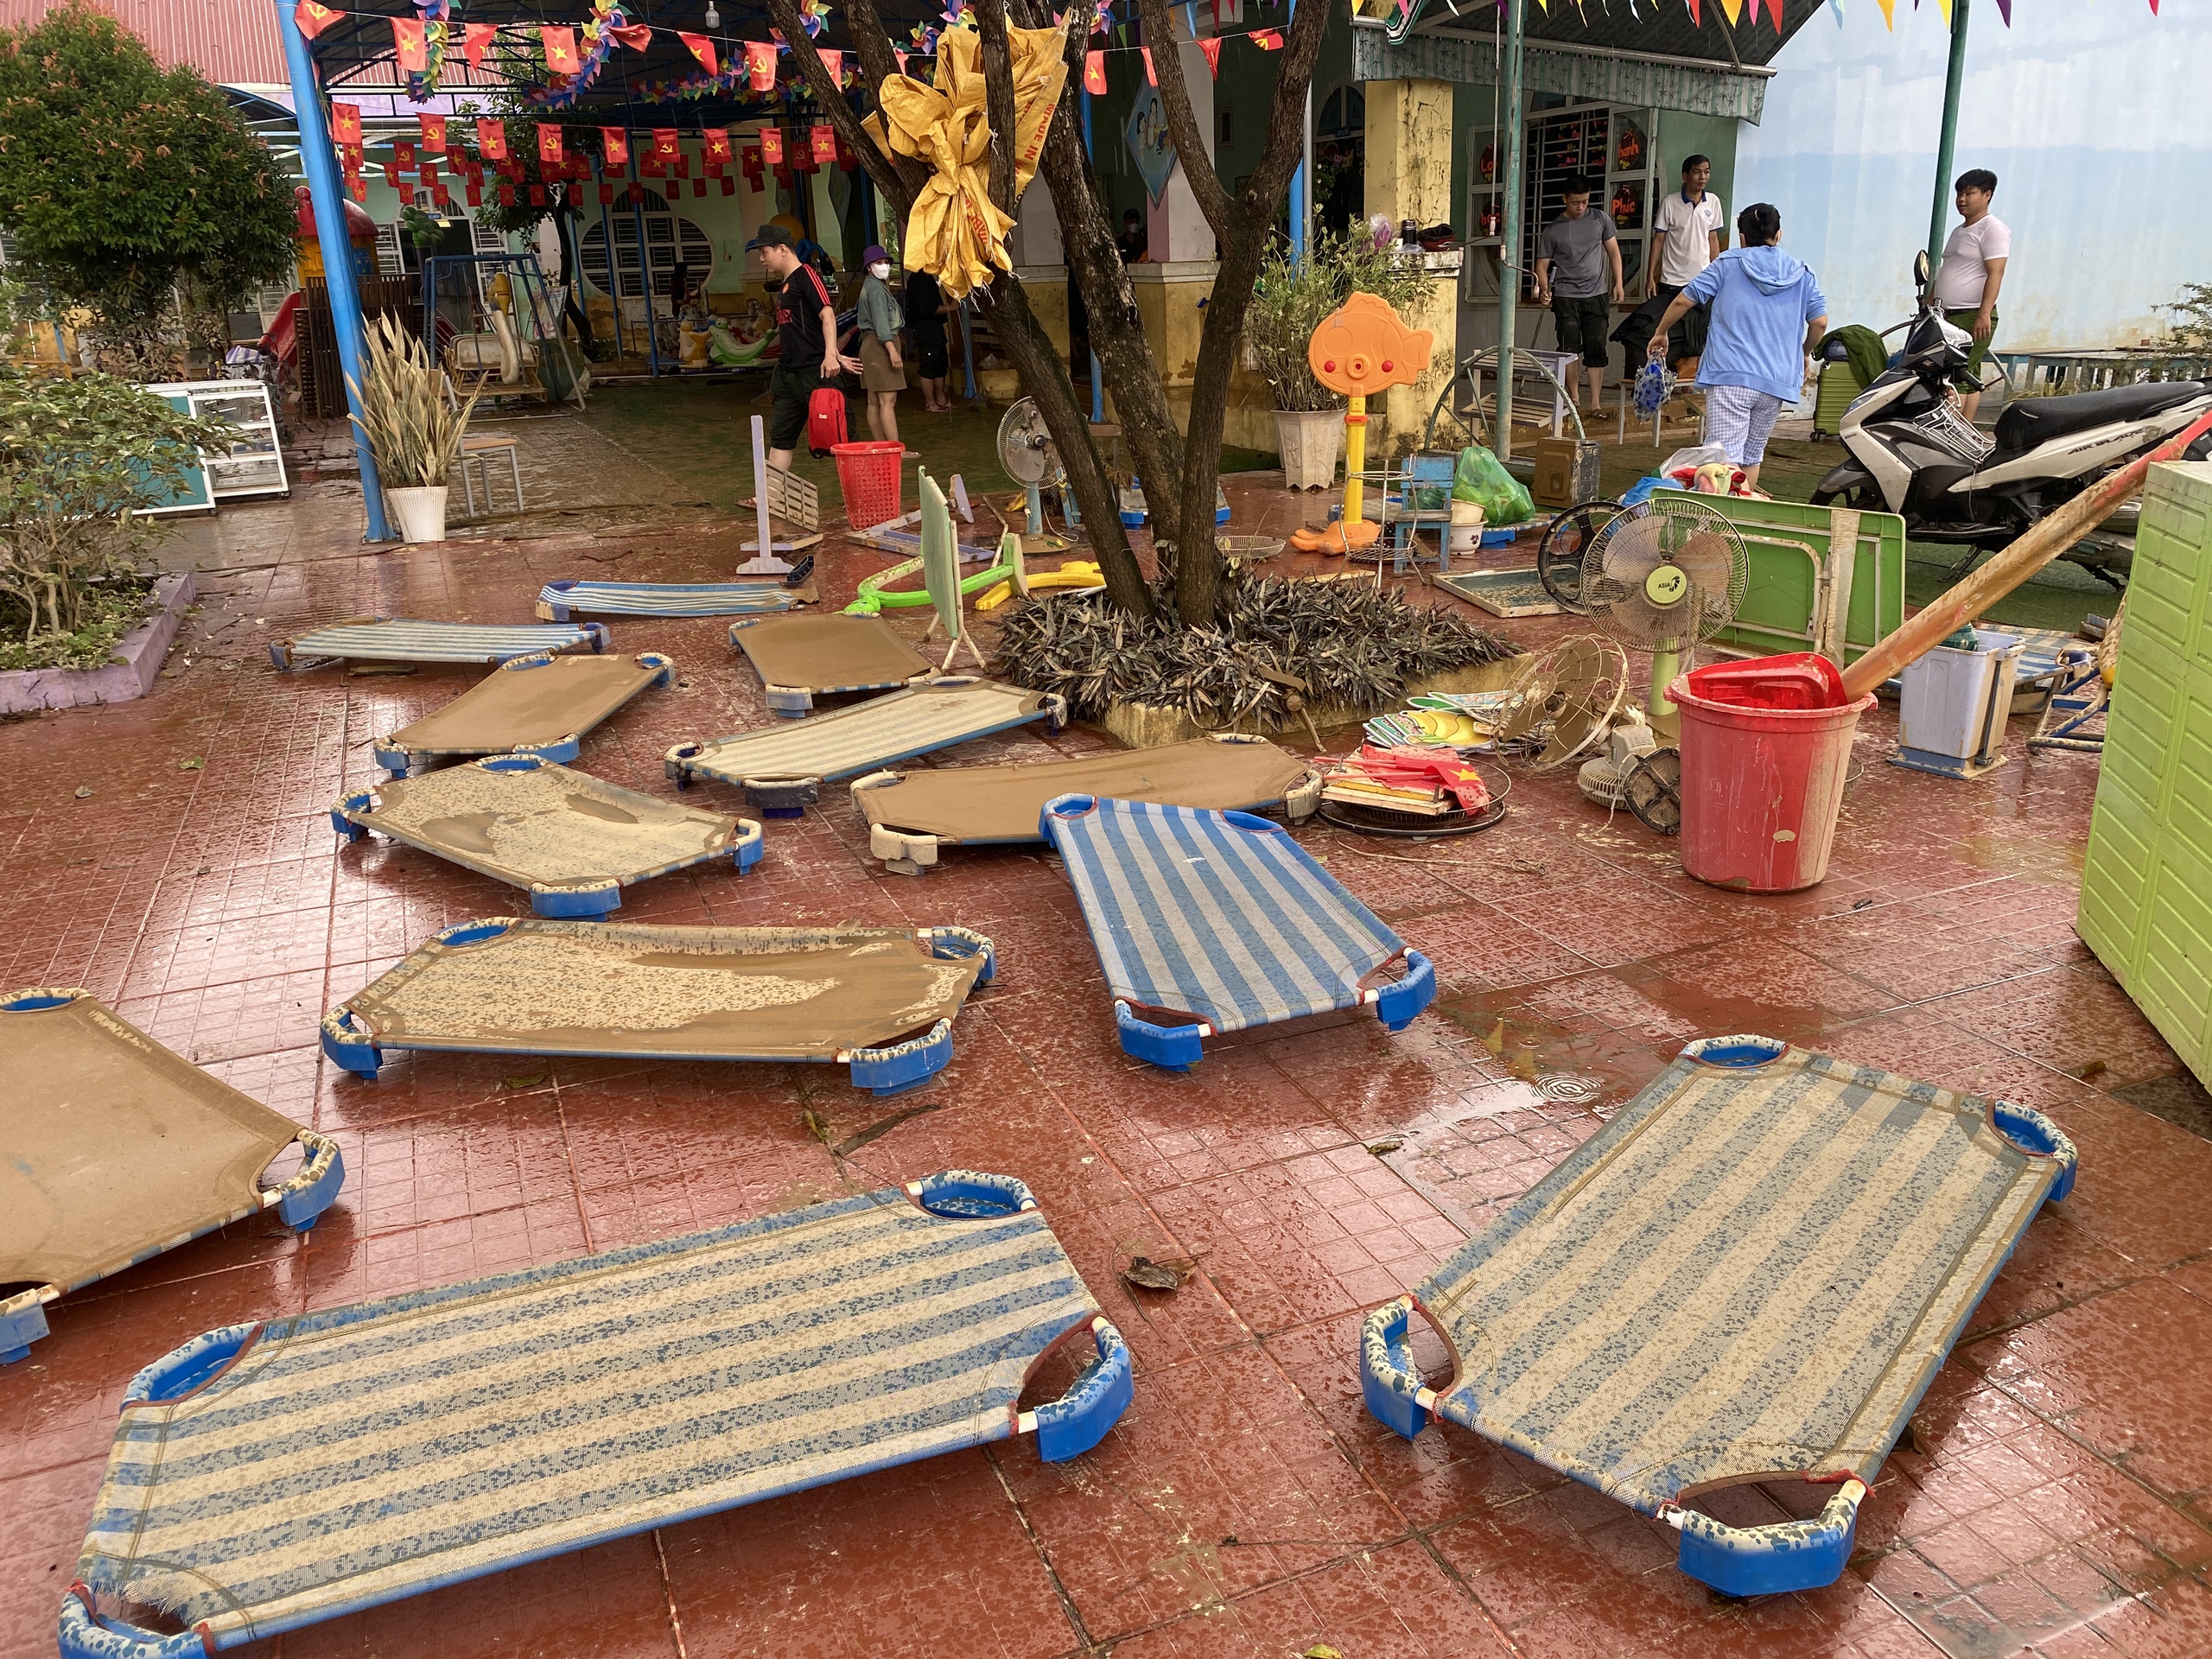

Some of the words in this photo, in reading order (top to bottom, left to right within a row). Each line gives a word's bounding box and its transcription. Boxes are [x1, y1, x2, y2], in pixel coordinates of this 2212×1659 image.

[1033, 103, 1055, 142] MADE
[1024, 144, 1039, 161] IN
[2067, 443, 2094, 455] AIR
